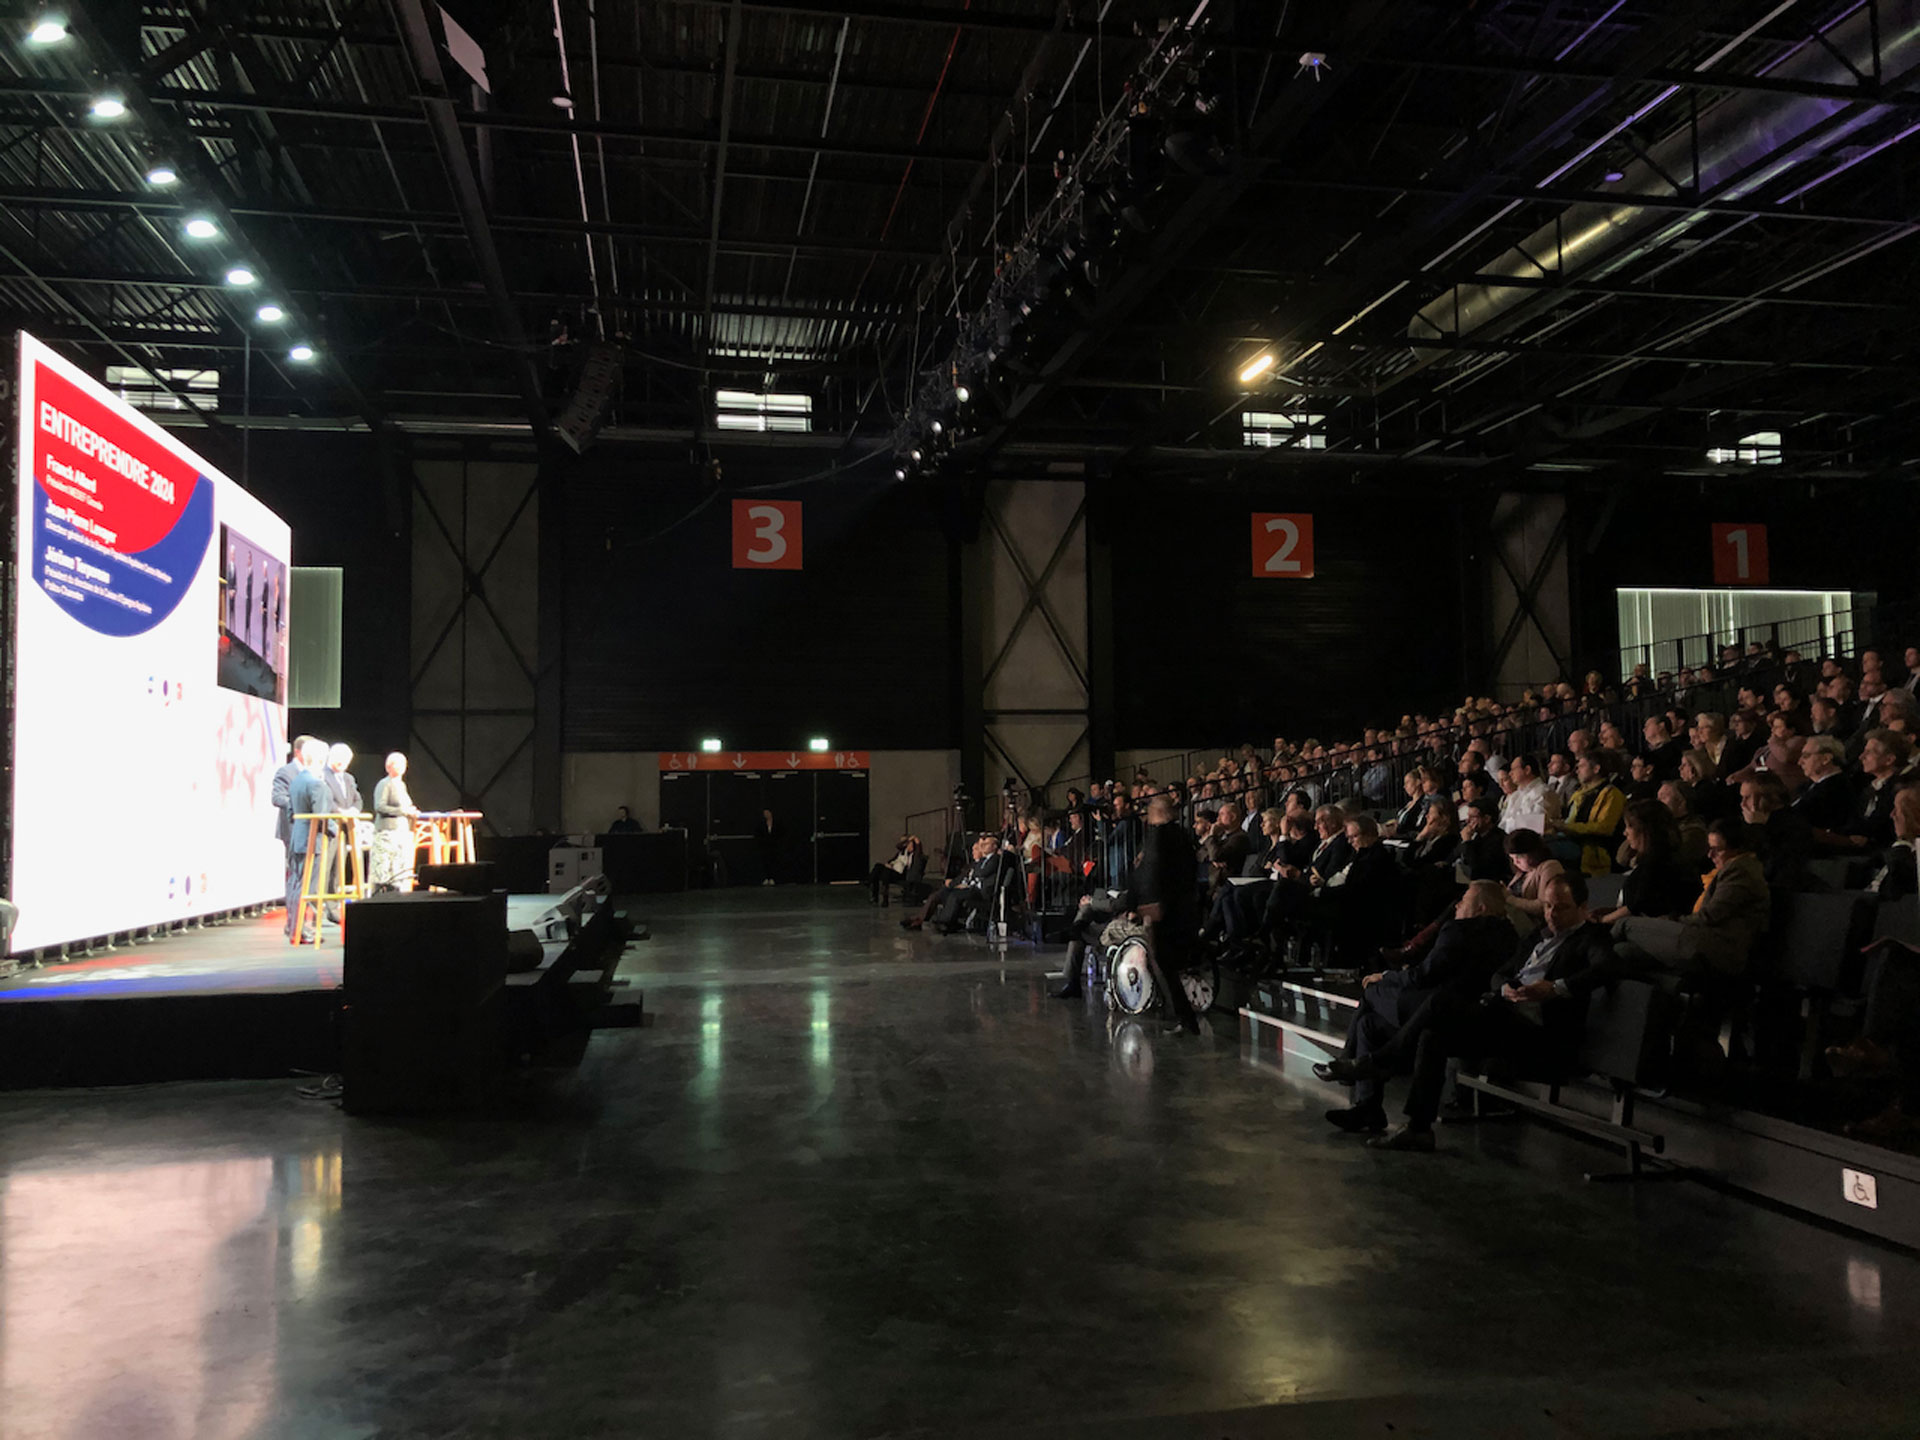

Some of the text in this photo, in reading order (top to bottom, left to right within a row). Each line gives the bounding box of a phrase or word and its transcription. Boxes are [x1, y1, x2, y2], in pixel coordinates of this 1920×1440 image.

[40, 400, 149, 490] ENTREPRENDRE
[150, 470, 175, 505] 2024
[748, 505, 786, 562] 3
[1265, 519, 1300, 572] 2
[1727, 529, 1749, 578] 1
